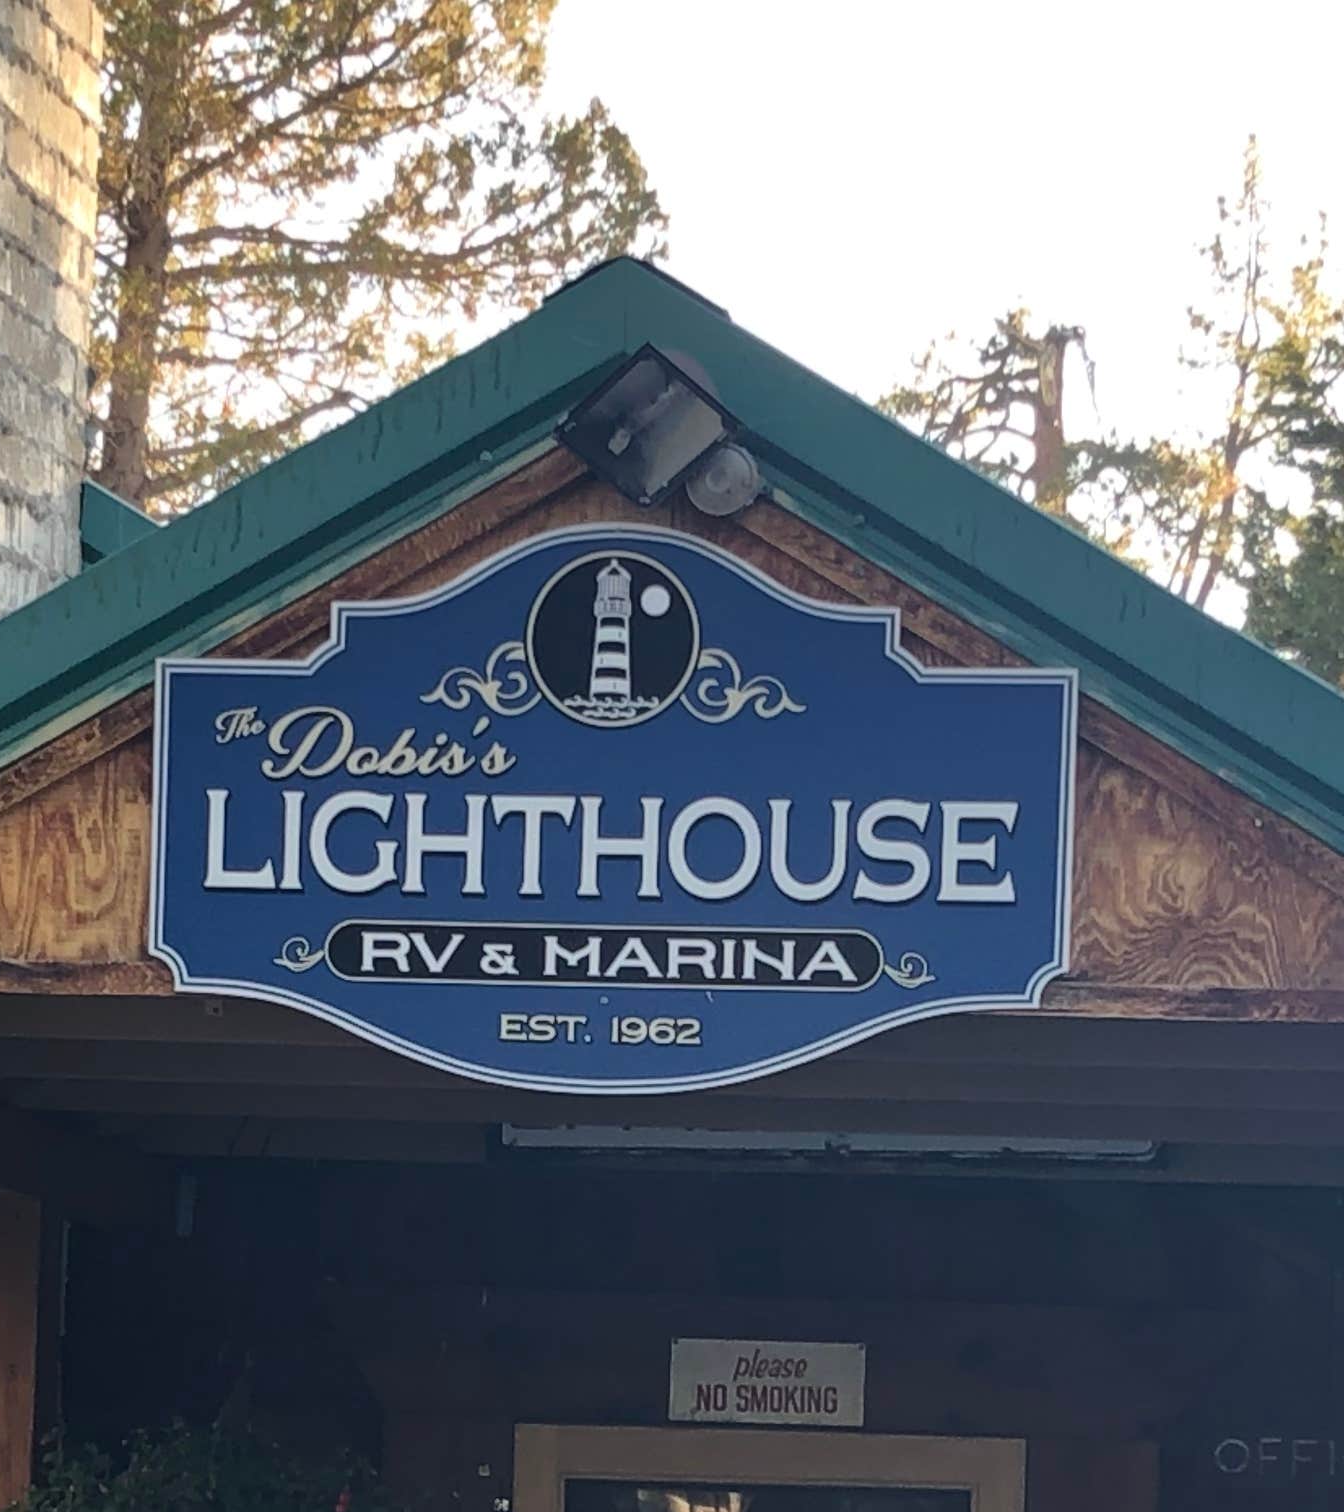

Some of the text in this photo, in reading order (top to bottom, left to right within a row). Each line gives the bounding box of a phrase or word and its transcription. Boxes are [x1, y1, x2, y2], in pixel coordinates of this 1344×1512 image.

[215, 707, 268, 745] The
[261, 706, 517, 779] Dobis's
[203, 788, 1018, 903] LIGHTHOUSE
[360, 931, 857, 982] RV & MARINA
[499, 1014, 703, 1045] EST. 1962
[733, 1348, 808, 1381] please
[695, 1383, 839, 1414] NO SMOKING
